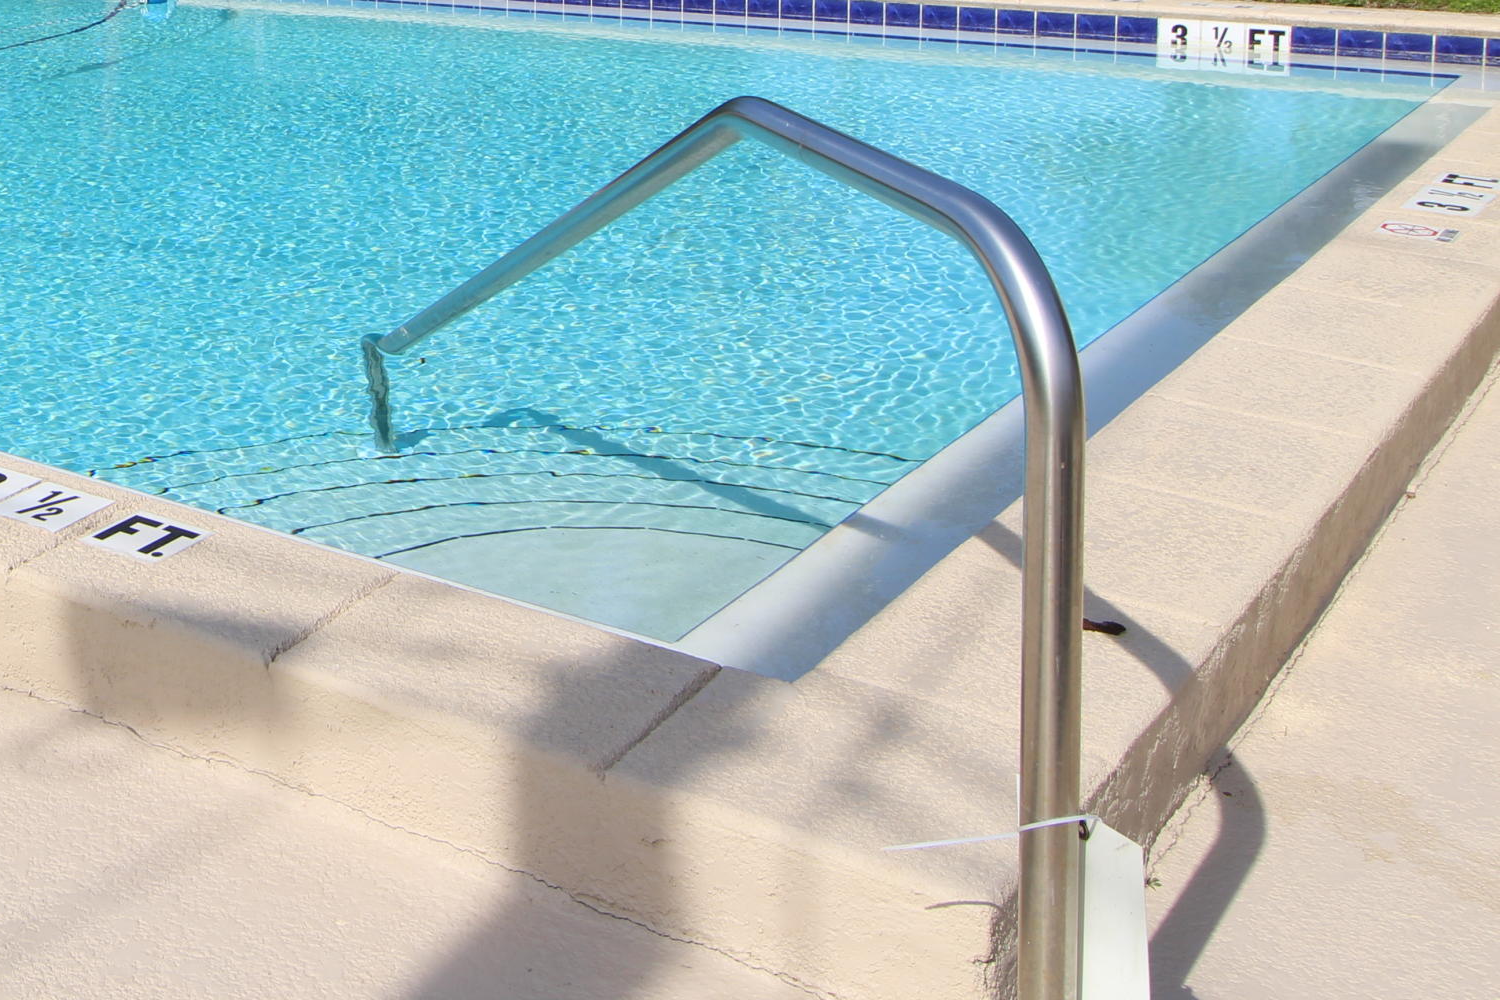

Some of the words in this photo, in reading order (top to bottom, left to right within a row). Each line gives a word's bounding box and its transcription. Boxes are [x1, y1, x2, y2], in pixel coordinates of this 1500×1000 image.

[1170, 24, 1188, 48] 3
[1248, 28, 1286, 52] FT
[1415, 200, 1470, 212] 3
[93, 514, 200, 558] FT.
